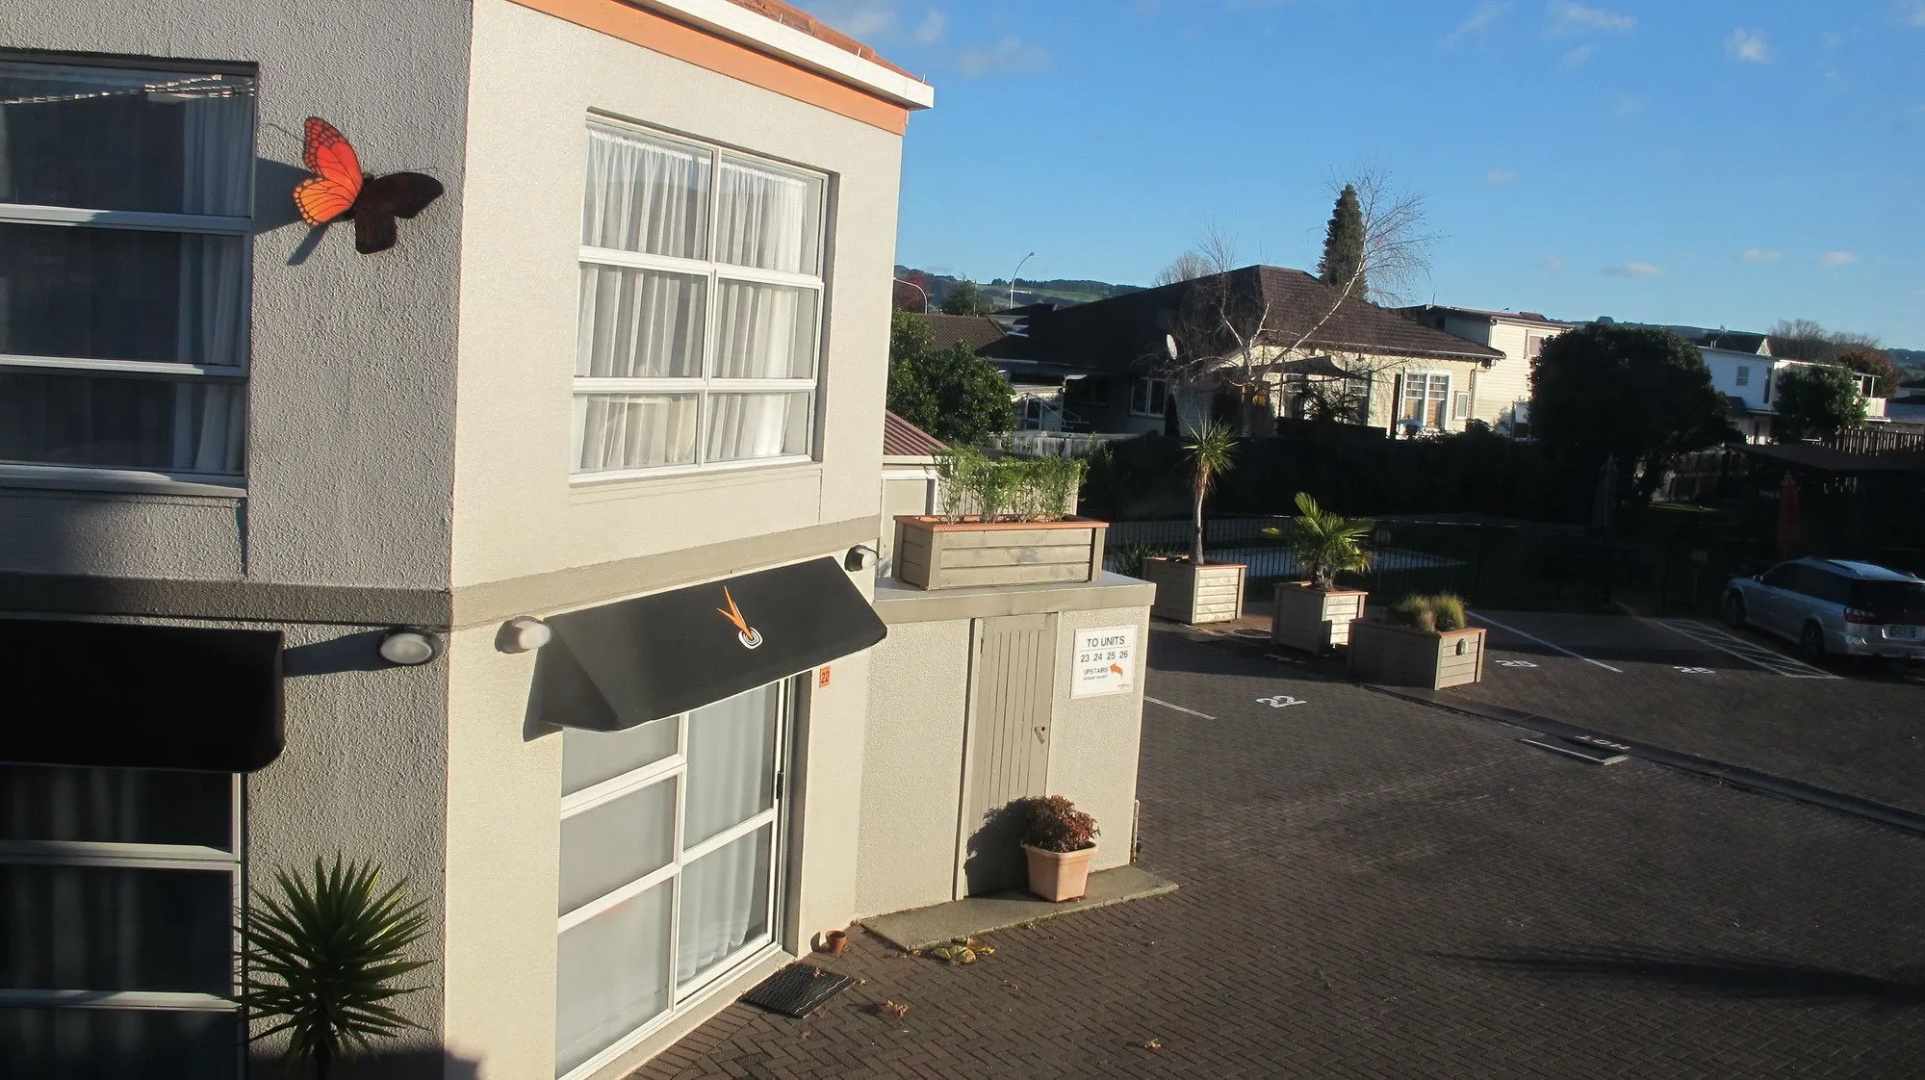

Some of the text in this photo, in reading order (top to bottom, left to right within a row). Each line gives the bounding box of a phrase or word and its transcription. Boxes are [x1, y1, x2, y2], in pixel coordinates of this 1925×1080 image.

[1086, 636, 1125, 648] TO UNITS
[1080, 650, 1128, 662] 23 24 25 26
[821, 670, 830, 684] 22
[1084, 666, 1108, 676] UPSTAIRS
[1256, 695, 1307, 708] 22
